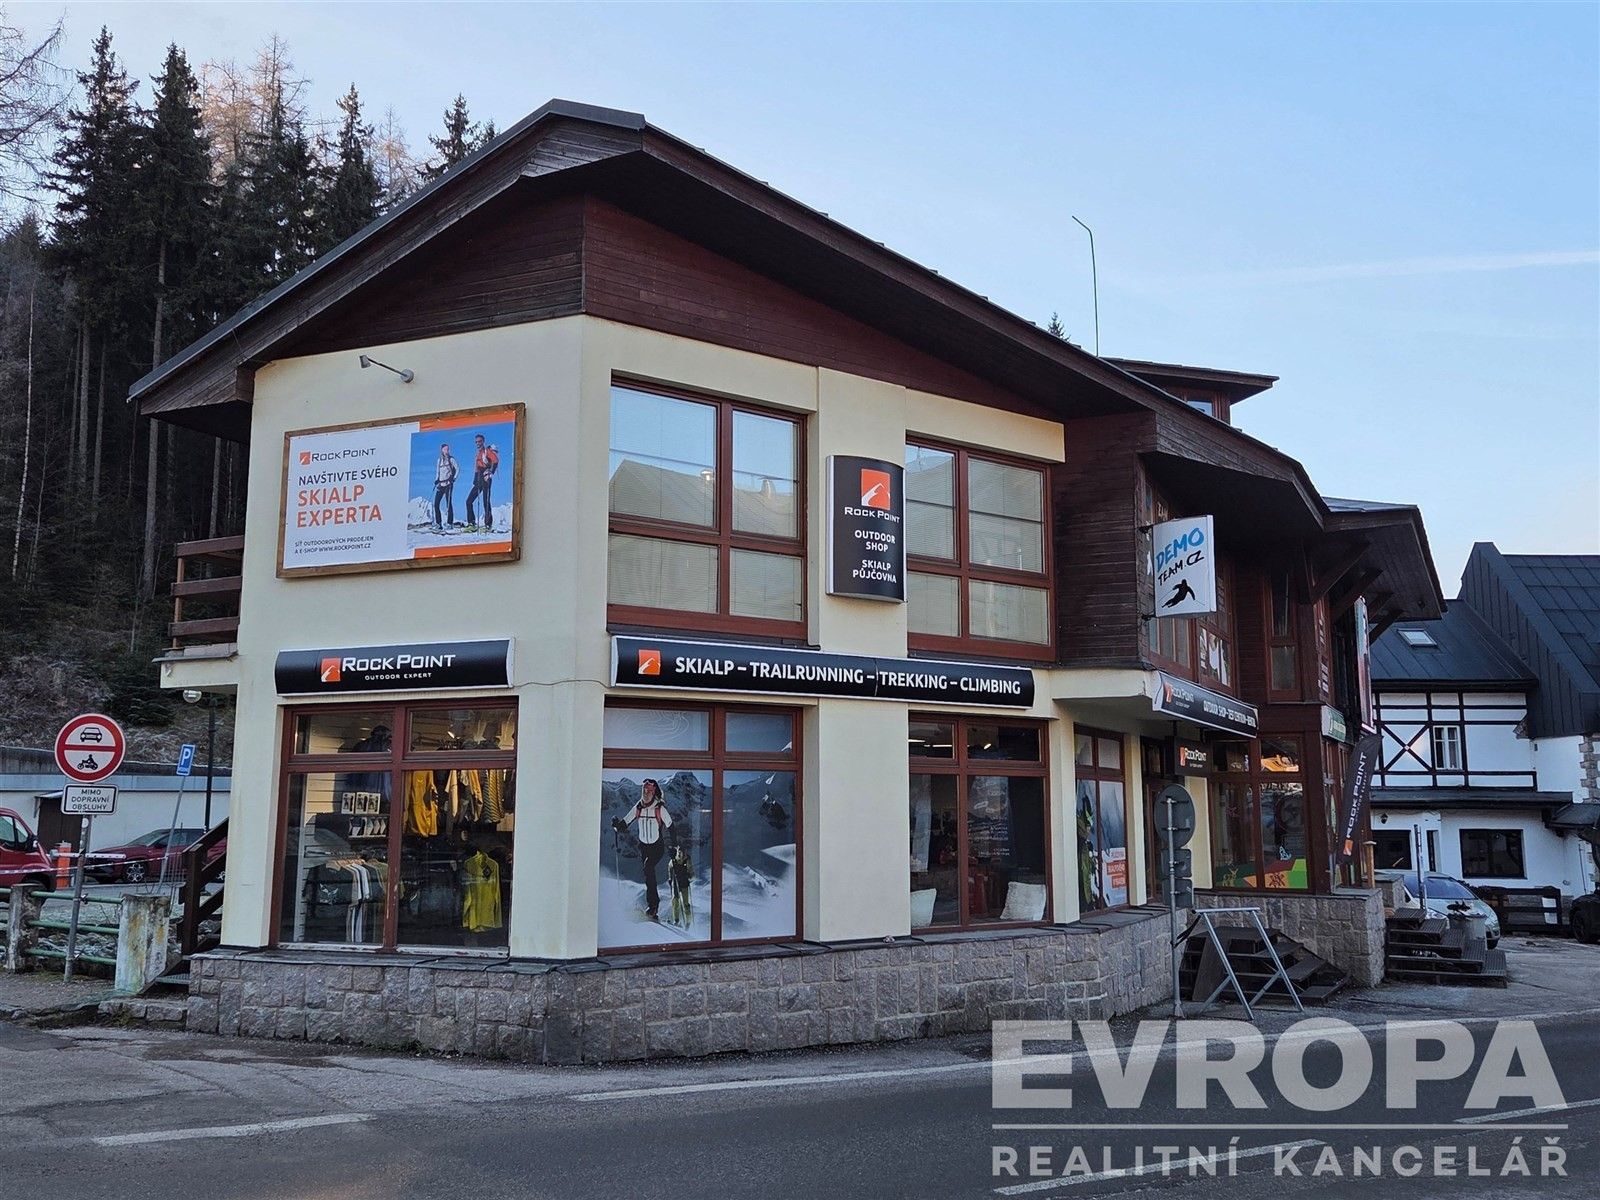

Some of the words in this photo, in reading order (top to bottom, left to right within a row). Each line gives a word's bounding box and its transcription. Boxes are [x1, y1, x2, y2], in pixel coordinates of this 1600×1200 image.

[311, 451, 342, 462] ROCK
[342, 447, 376, 458] POINT
[298, 471, 357, 486] NAVŠTIVTE
[360, 465, 398, 480] SVÉHO
[298, 485, 364, 507] SKIALP
[297, 504, 382, 528] EXPERTA
[844, 506, 875, 518] ROCK
[877, 509, 900, 524] POINT
[854, 529, 896, 544] OUTDOOR
[865, 541, 889, 552] SHOP
[1156, 527, 1204, 573] DEMO
[861, 559, 892, 571] SKIALP
[1158, 550, 1205, 586] TEAM.CZ
[852, 567, 897, 583] PŮJČOVNA
[342, 656, 394, 672] ROCK
[397, 654, 456, 670] POINT
[181, 747, 191, 766] P
[1353, 751, 1367, 797] POINT
[71, 795, 110, 803] DOPRAVNÍ
[72, 803, 107, 811] OBSLUHY
